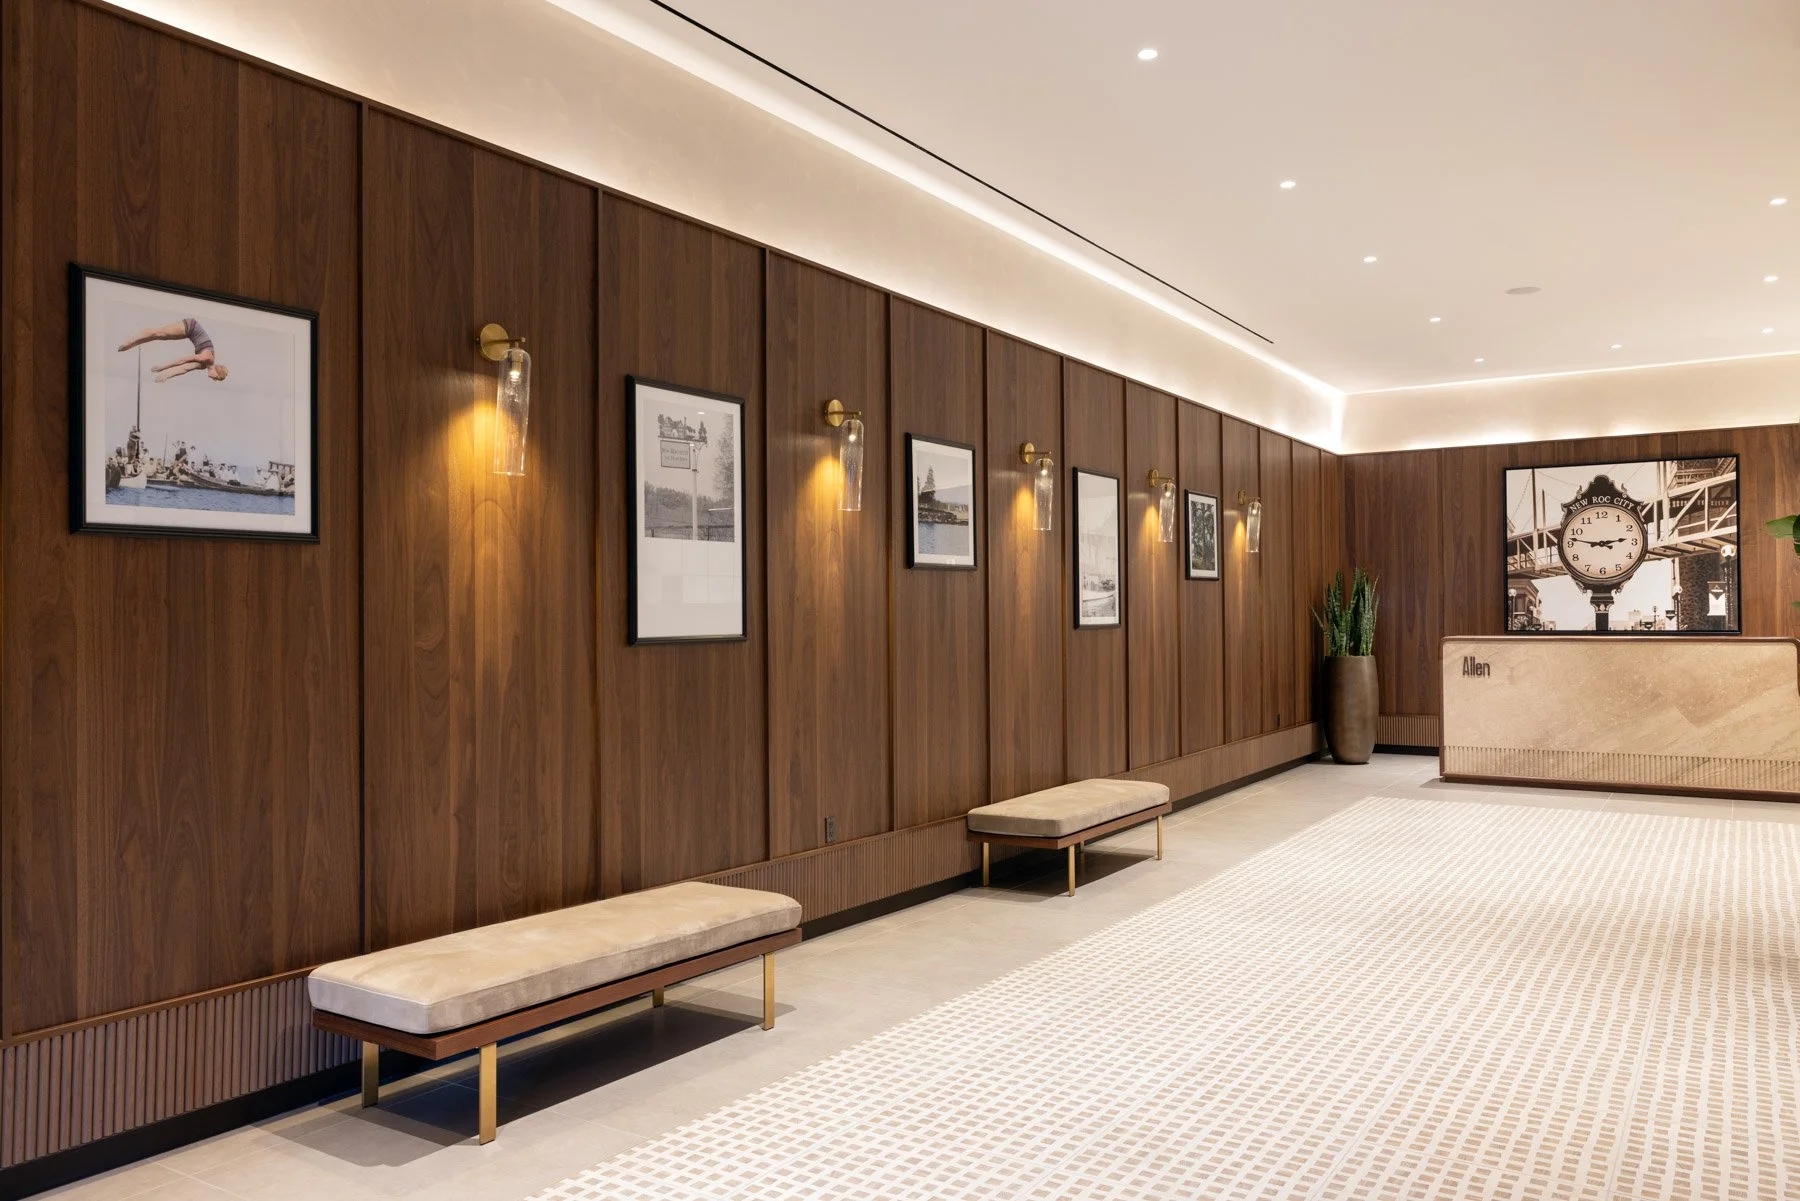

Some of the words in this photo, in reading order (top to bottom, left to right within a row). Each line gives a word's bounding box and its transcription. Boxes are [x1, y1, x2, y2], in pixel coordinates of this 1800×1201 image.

[1570, 498, 1588, 512] NEW
[1613, 497, 1634, 510] CITY
[1595, 511, 1608, 519] 12
[1631, 538, 1638, 546] 3
[1584, 564, 1591, 572] 7
[1600, 567, 1606, 575] 6
[1463, 656, 1490, 677] Allen
